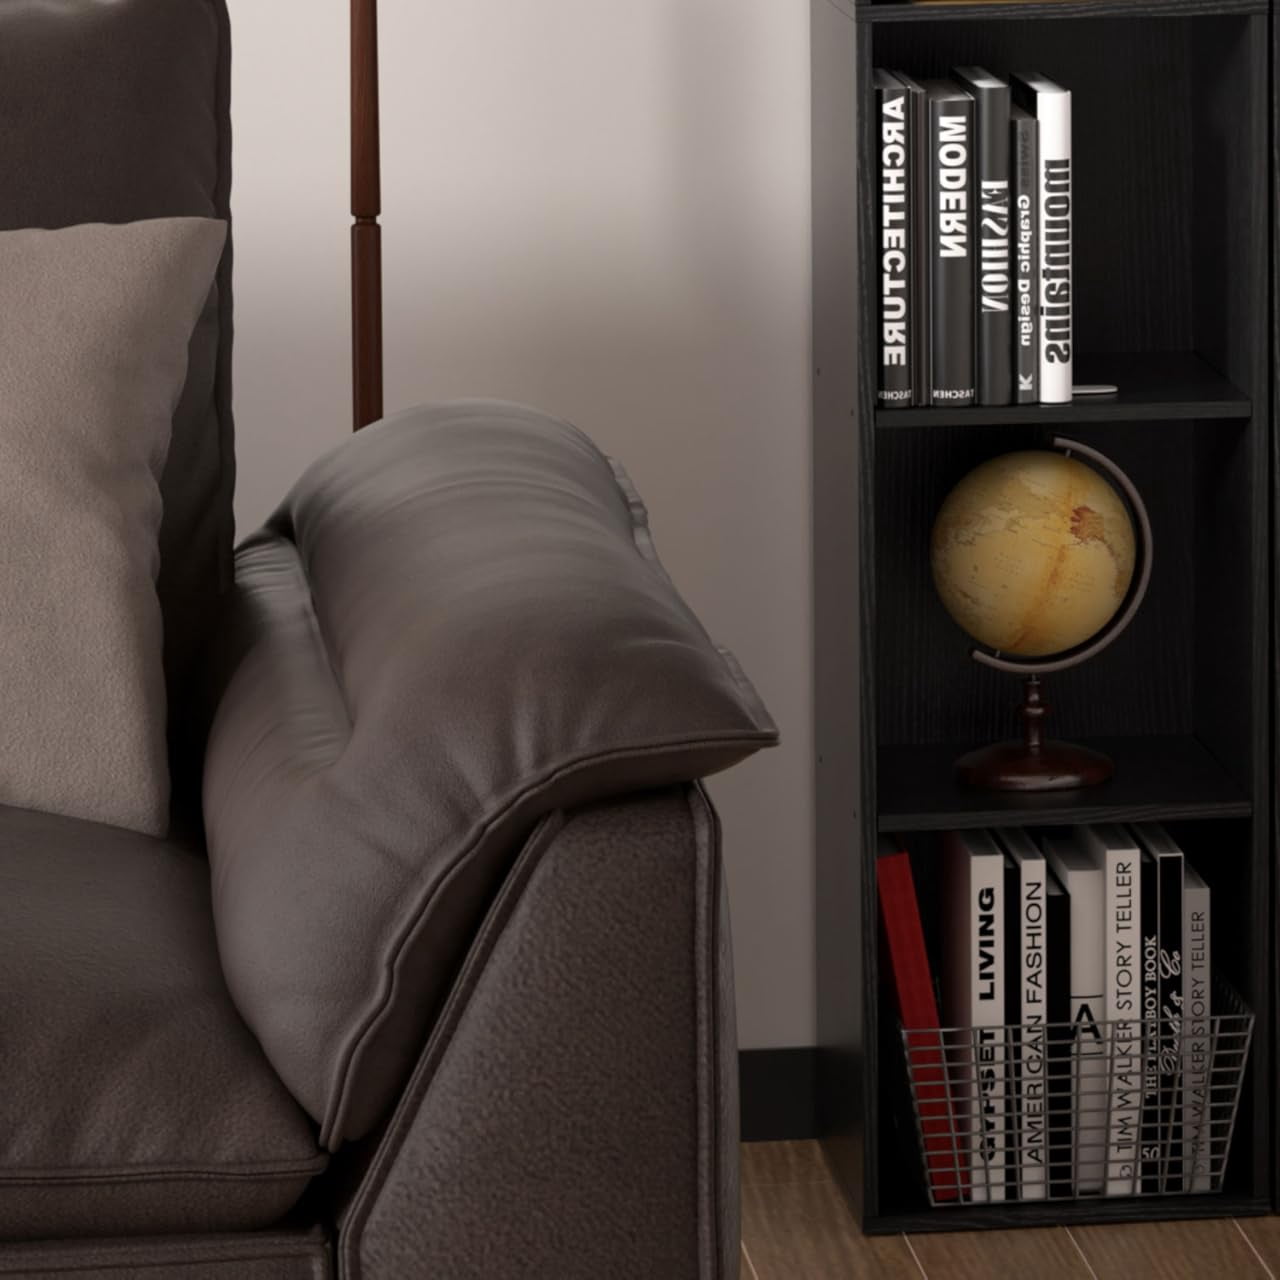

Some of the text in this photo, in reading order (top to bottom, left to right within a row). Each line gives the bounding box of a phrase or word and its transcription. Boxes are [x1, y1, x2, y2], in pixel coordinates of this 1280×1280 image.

[1026, 882, 1042, 1003] FASHION
[1144, 935, 1156, 982] BOOK
[1191, 910, 1205, 968] TELLER
[979, 887, 996, 1161] GYPSET LIVING
[1071, 1004, 1103, 1044] A
[1116, 861, 1132, 1153] TIM WALKER STORY TELLER
[1191, 977, 1205, 1036] STORY
